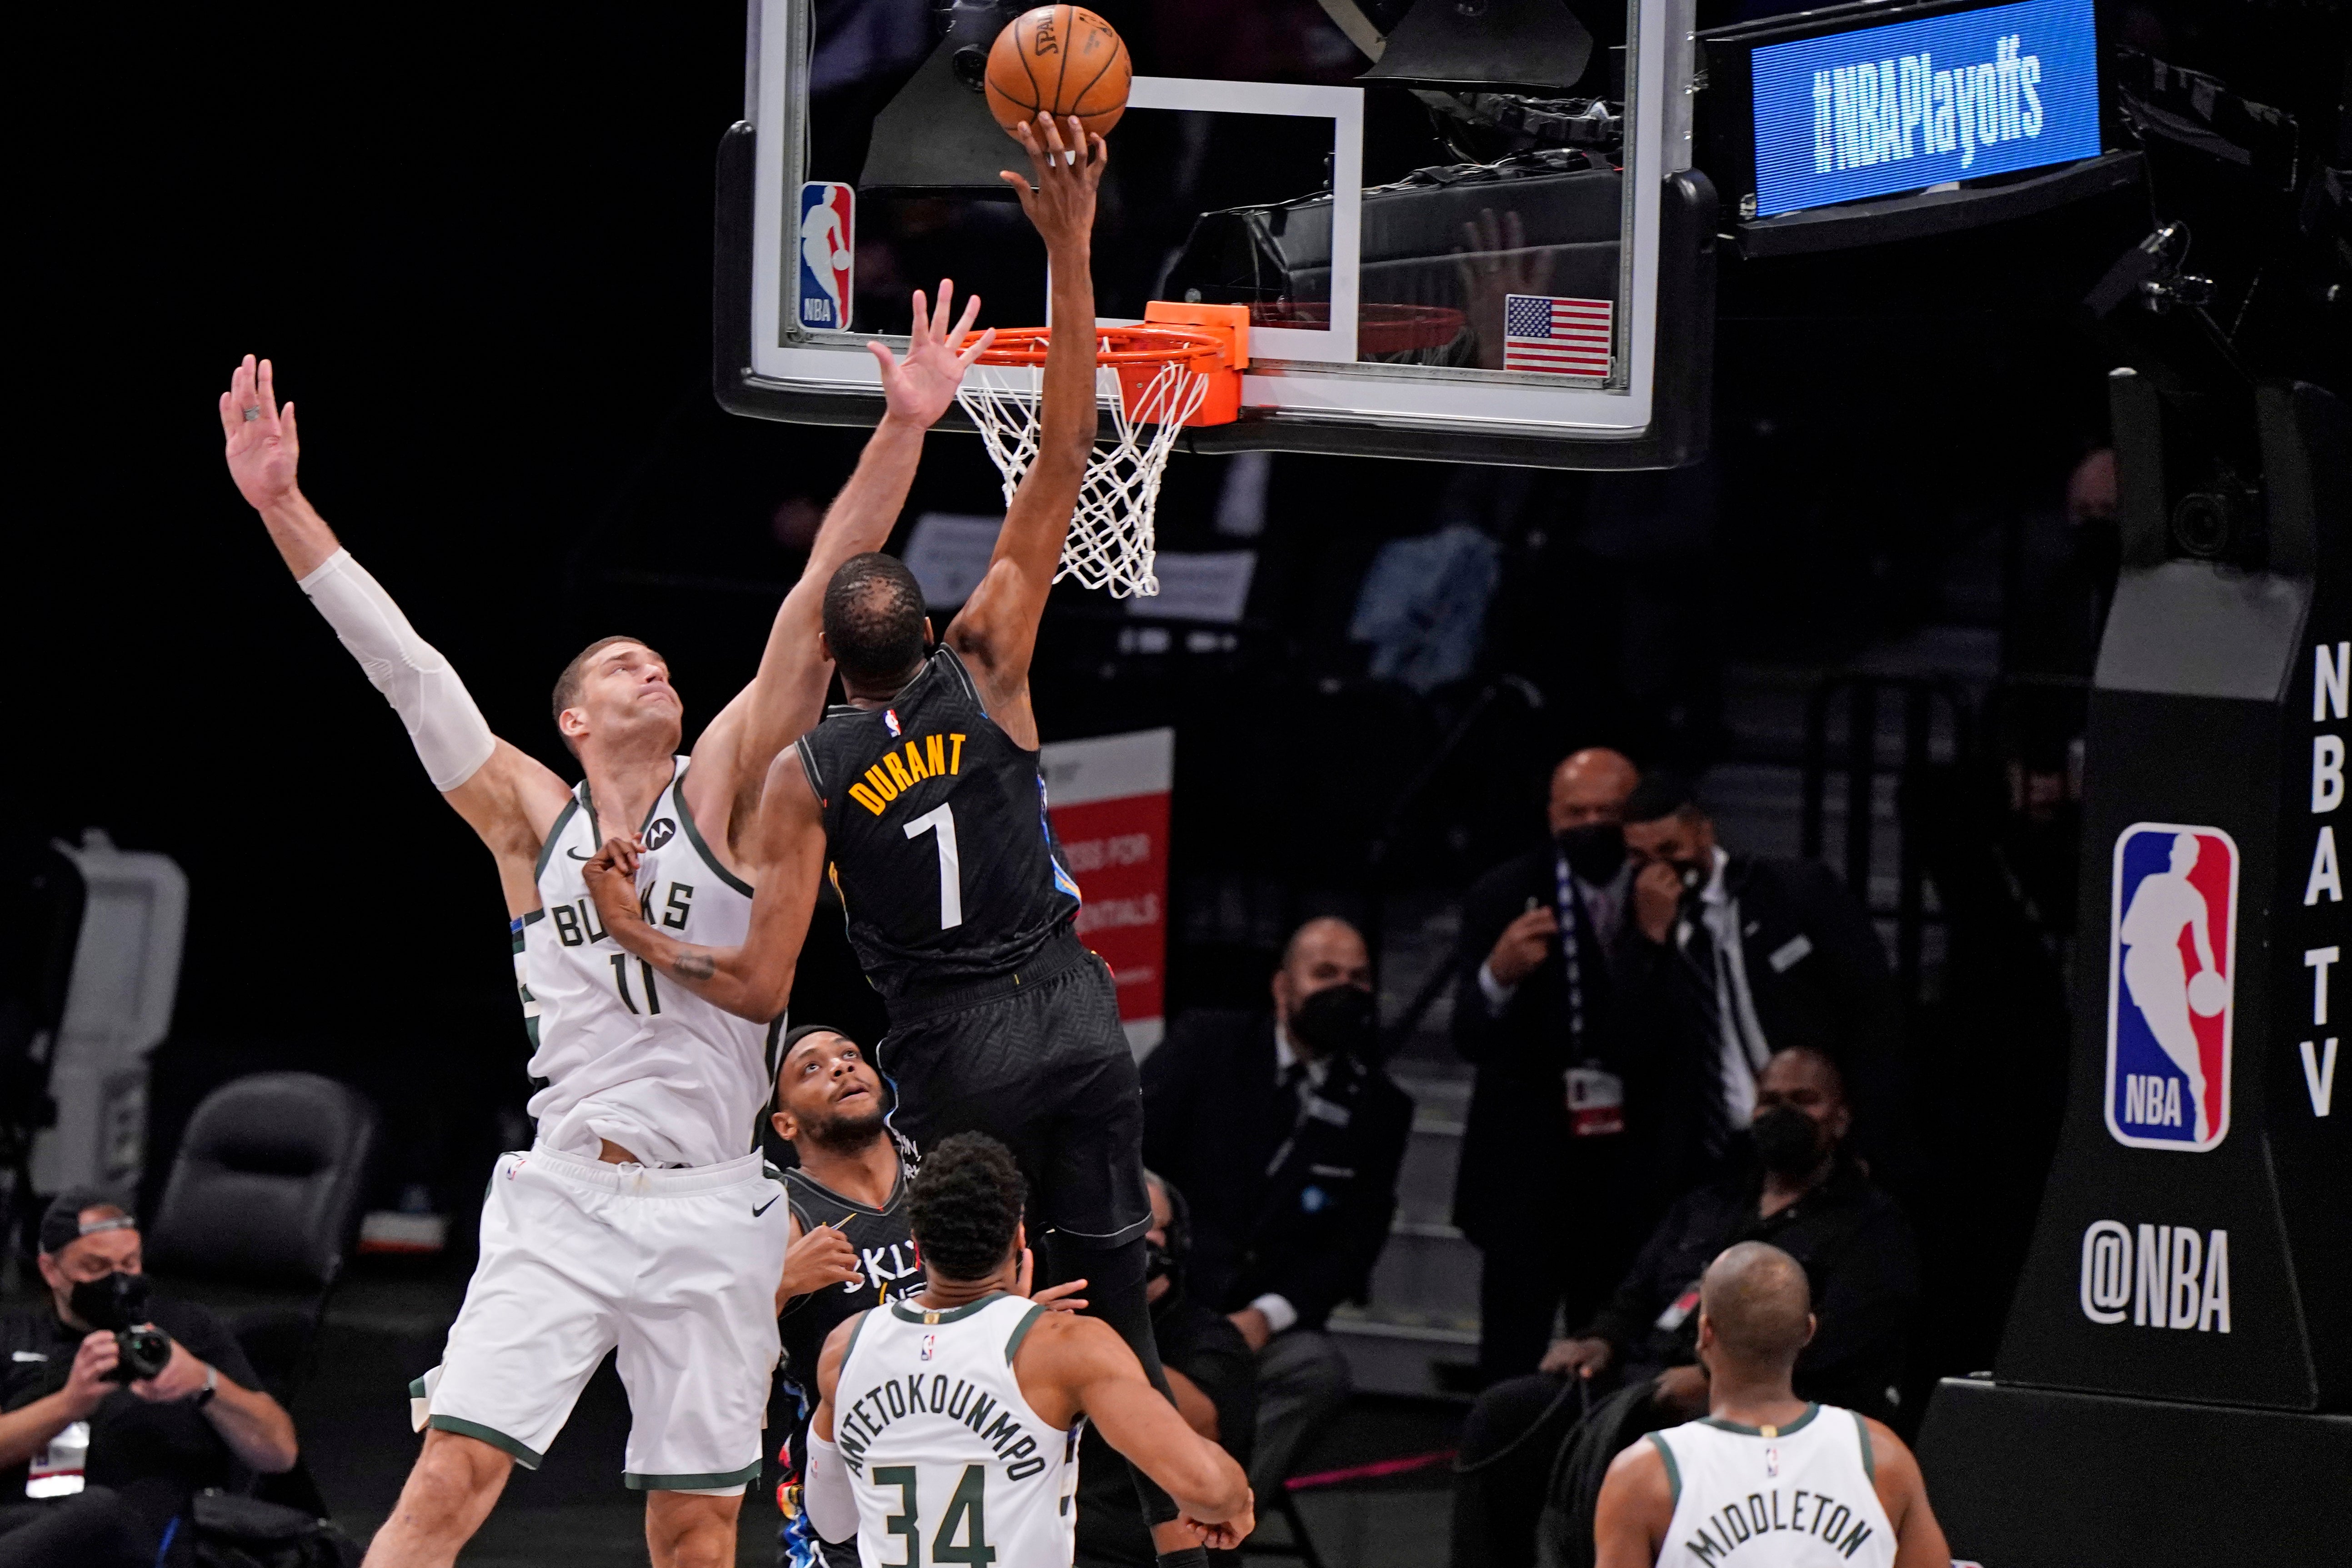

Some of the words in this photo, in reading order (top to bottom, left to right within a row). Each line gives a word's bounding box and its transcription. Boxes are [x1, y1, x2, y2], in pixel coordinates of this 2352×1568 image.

[1812, 35, 2043, 174] #NBAPlayoffs
[804, 298, 831, 321] NBA
[848, 733, 966, 816] DURANT
[2303, 641, 2351, 906] NBA
[551, 881, 695, 947] BUKS
[903, 802, 962, 930] 7
[611, 953, 661, 1017] 11
[2300, 946, 2340, 1117] TV
[2125, 1074, 2182, 1127] NBA
[2080, 1220, 2231, 1333] @NBA
[840, 1373, 1046, 1482] ANTETOKOUNMPO
[872, 1464, 996, 1568] 34
[1686, 1489, 1873, 1568] MIDDLETON
